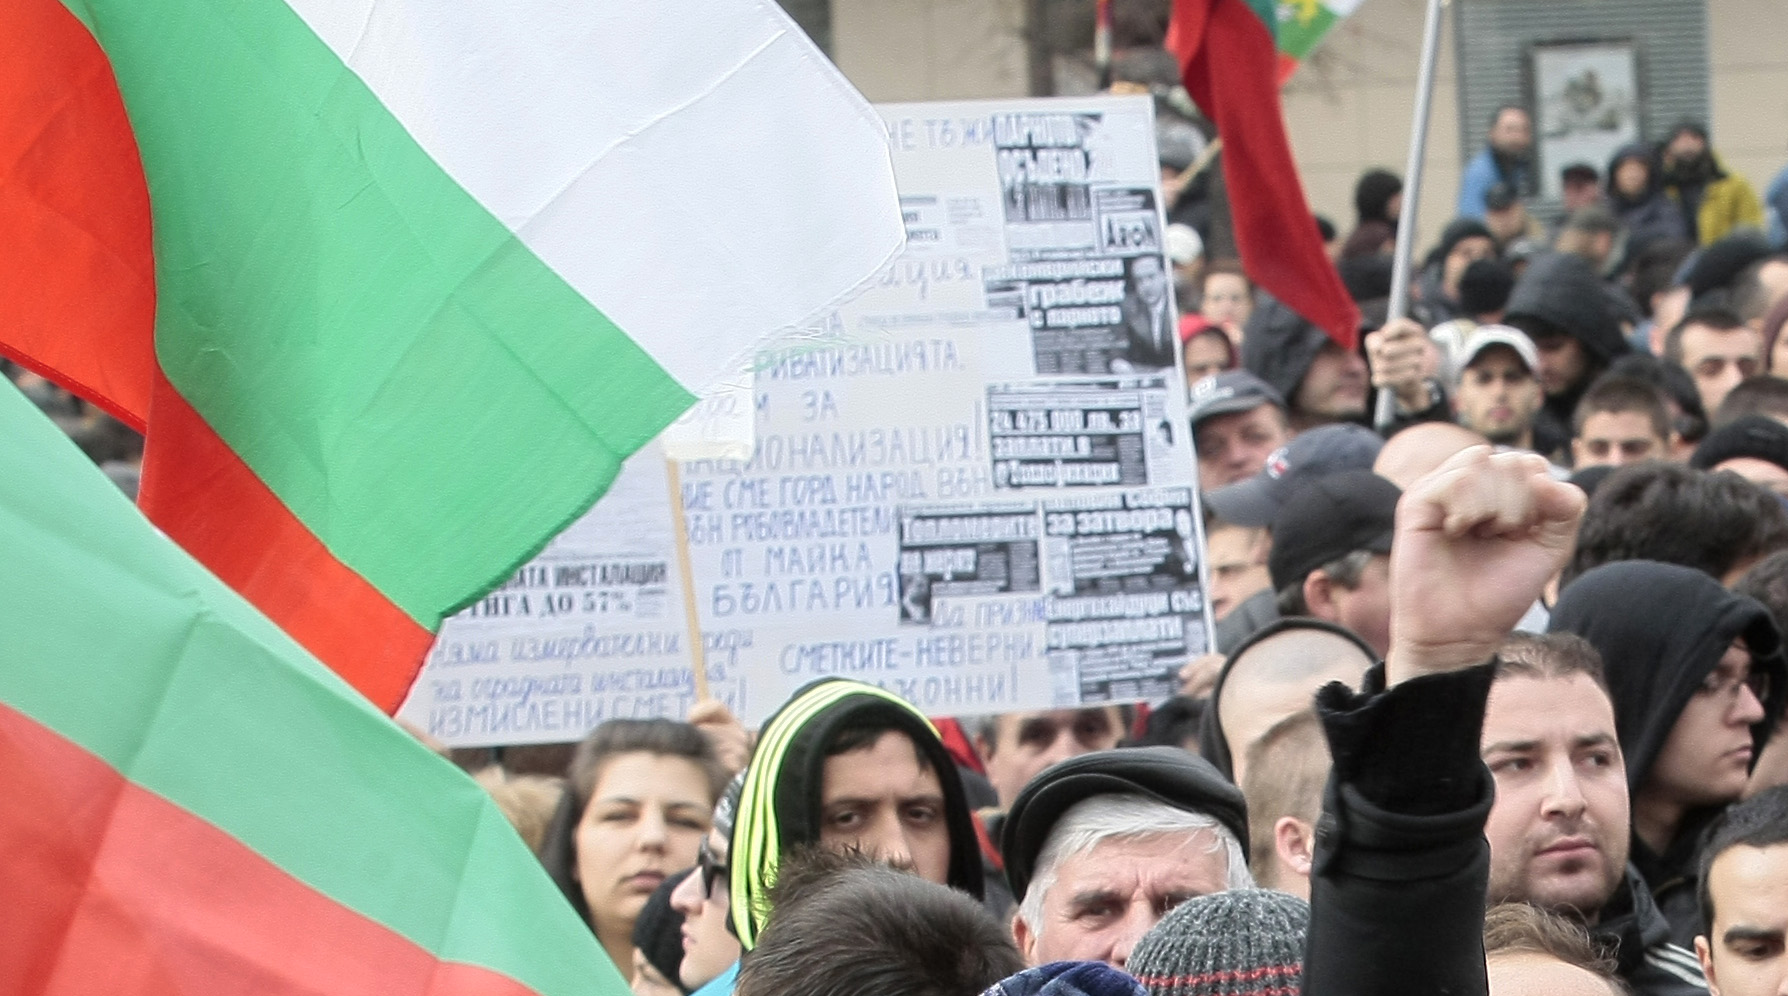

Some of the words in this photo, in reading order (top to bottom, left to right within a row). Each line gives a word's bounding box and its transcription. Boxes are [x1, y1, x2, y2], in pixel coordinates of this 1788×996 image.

[754, 338, 966, 381] РИВАТИЗАЦИЯТА.
[1077, 509, 1174, 534] затвора
[765, 541, 873, 575] МАЙКА
[712, 573, 897, 617] БЪЛГАРИЯ
